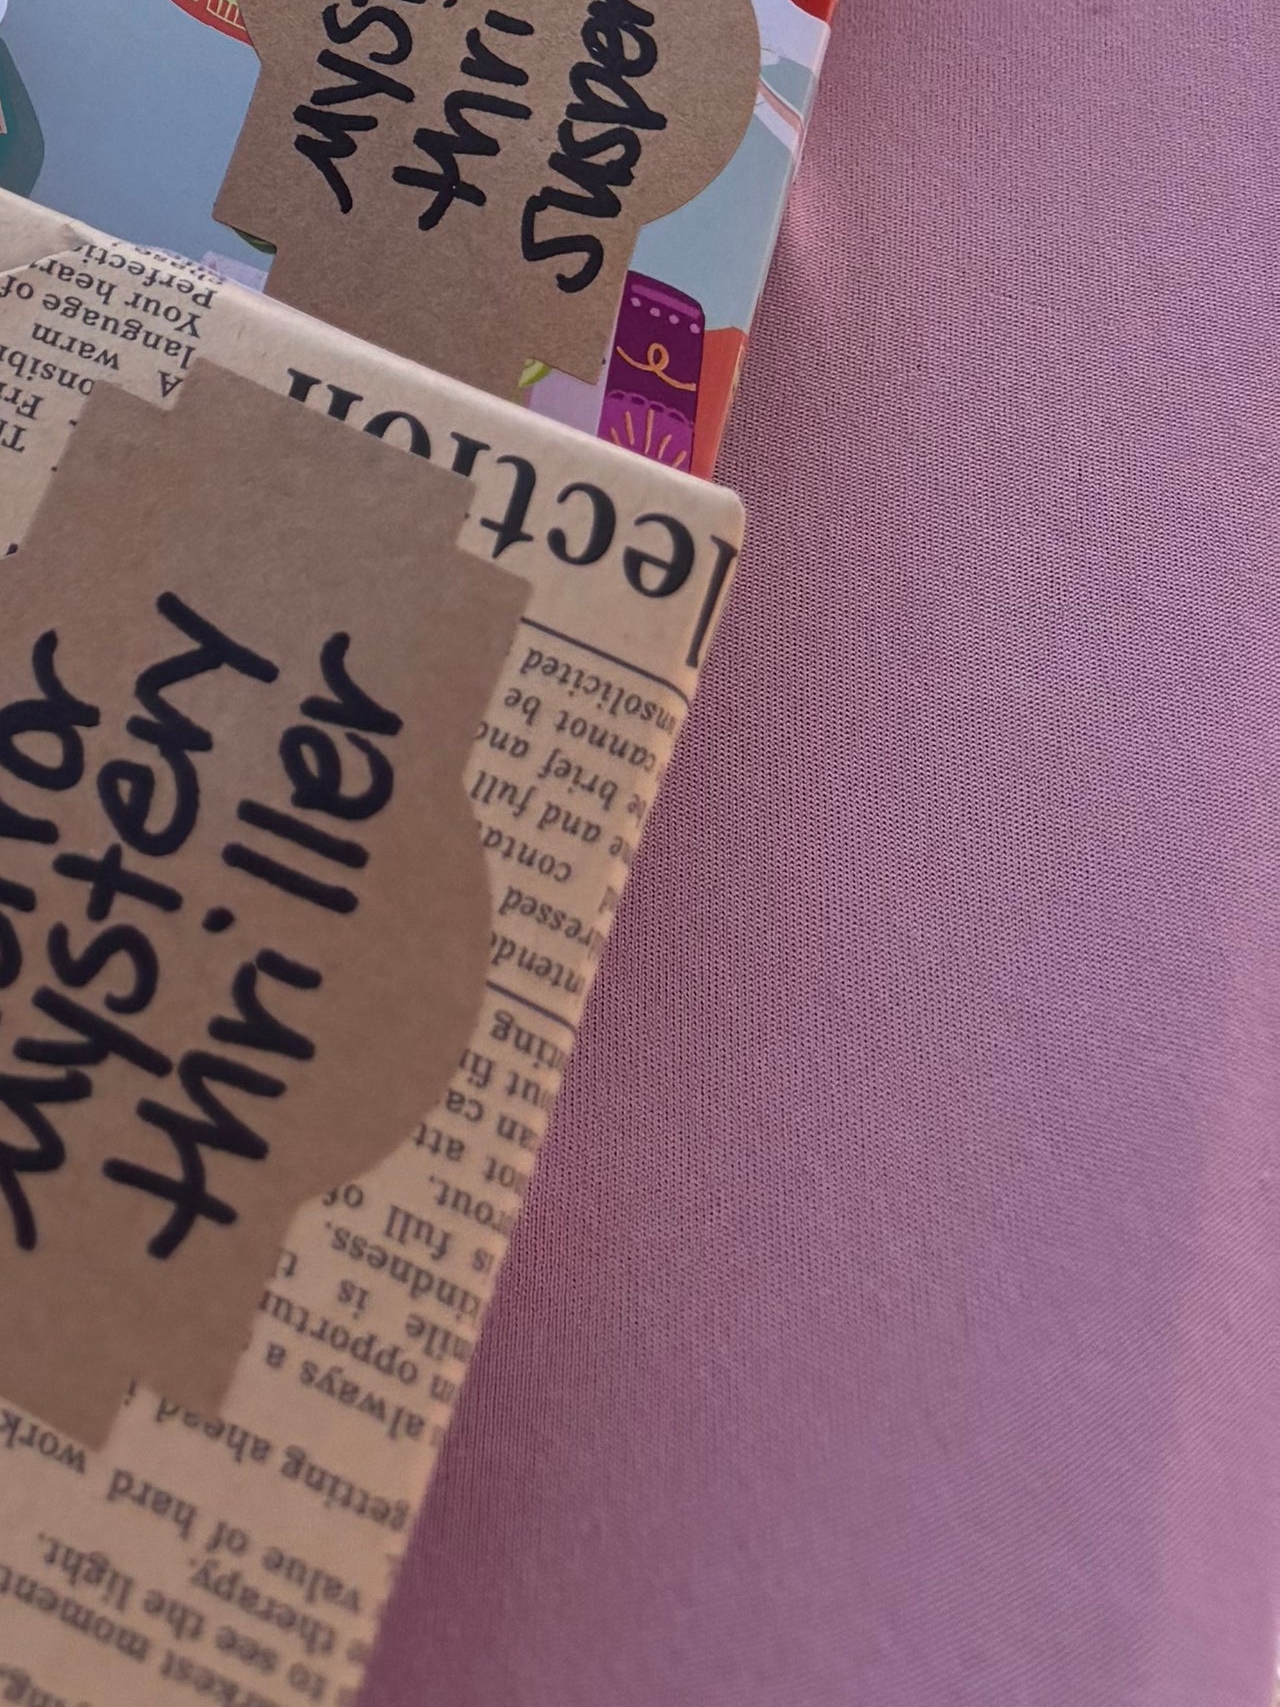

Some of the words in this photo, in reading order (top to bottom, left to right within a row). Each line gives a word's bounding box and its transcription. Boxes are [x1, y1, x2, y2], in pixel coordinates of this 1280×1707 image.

[41, 291, 197, 372] language
[103, 629, 406, 1260] thriller
[105, 1469, 200, 1541] hard
